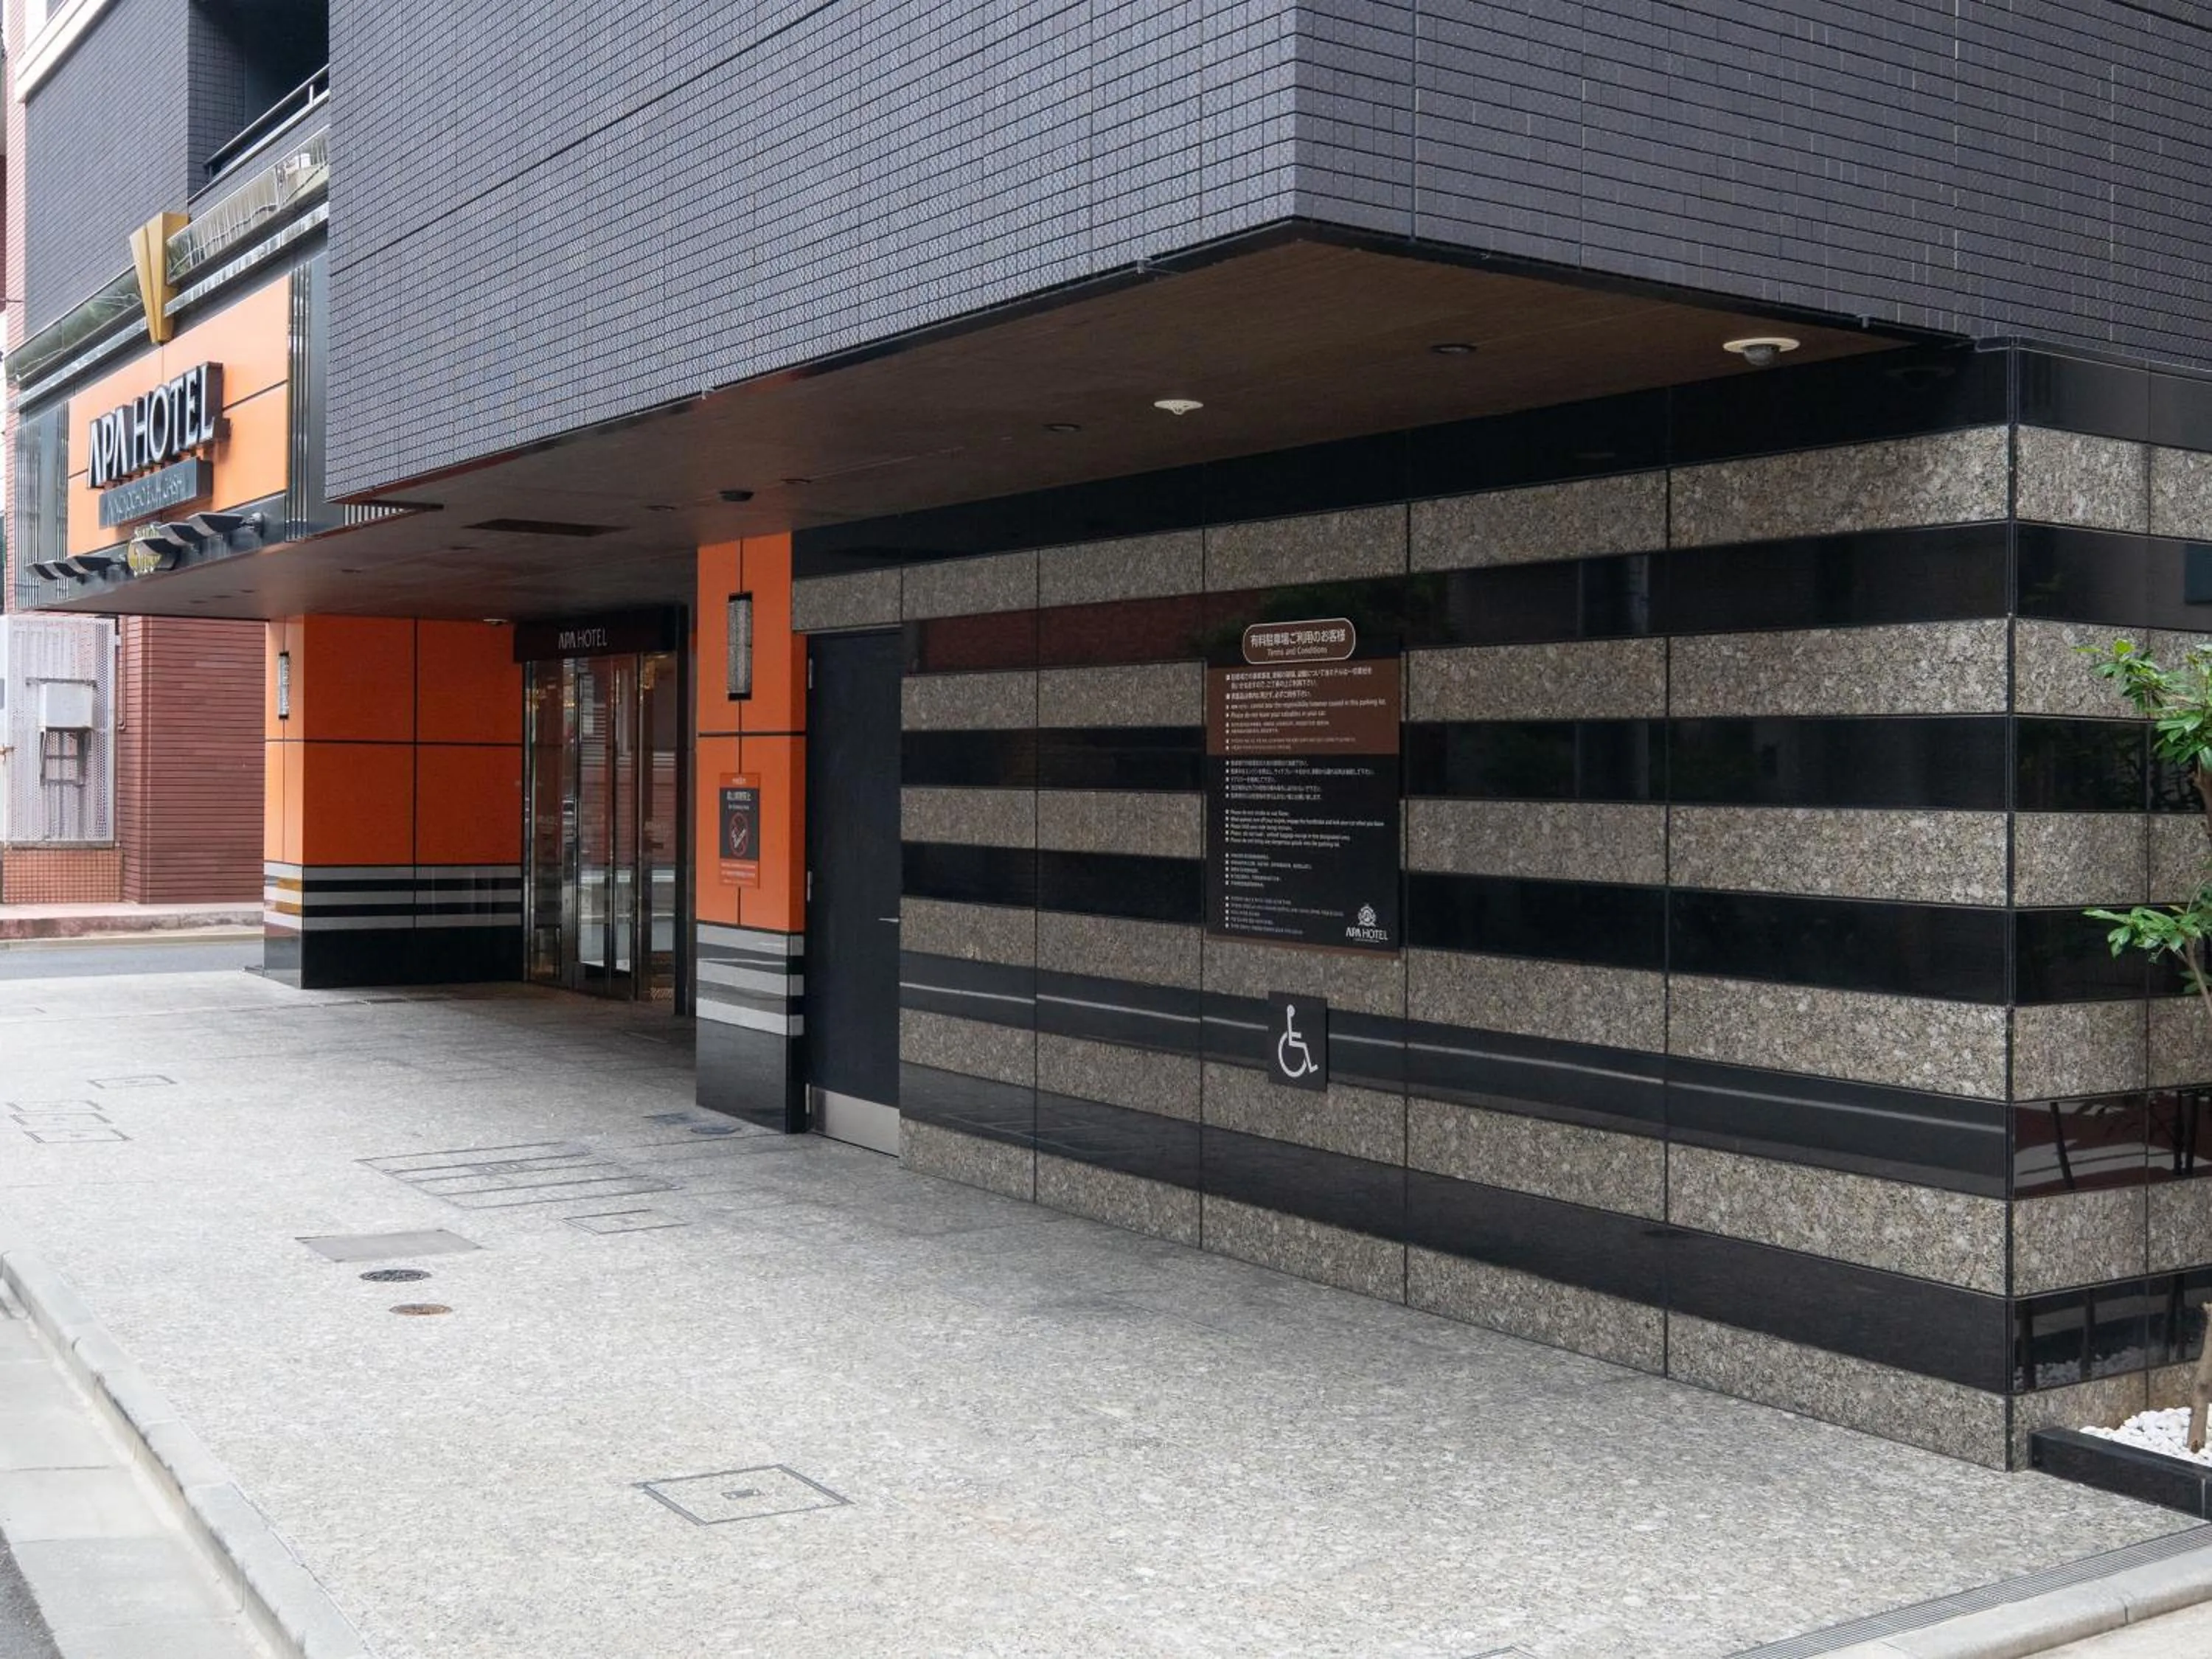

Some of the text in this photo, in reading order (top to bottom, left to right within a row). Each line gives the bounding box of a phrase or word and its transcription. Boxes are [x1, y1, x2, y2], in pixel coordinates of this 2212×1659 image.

[88, 362, 217, 489] APA HOTEL
[558, 627, 608, 650] APA HOTEL
[1346, 927, 1388, 940] APA HOTEL
